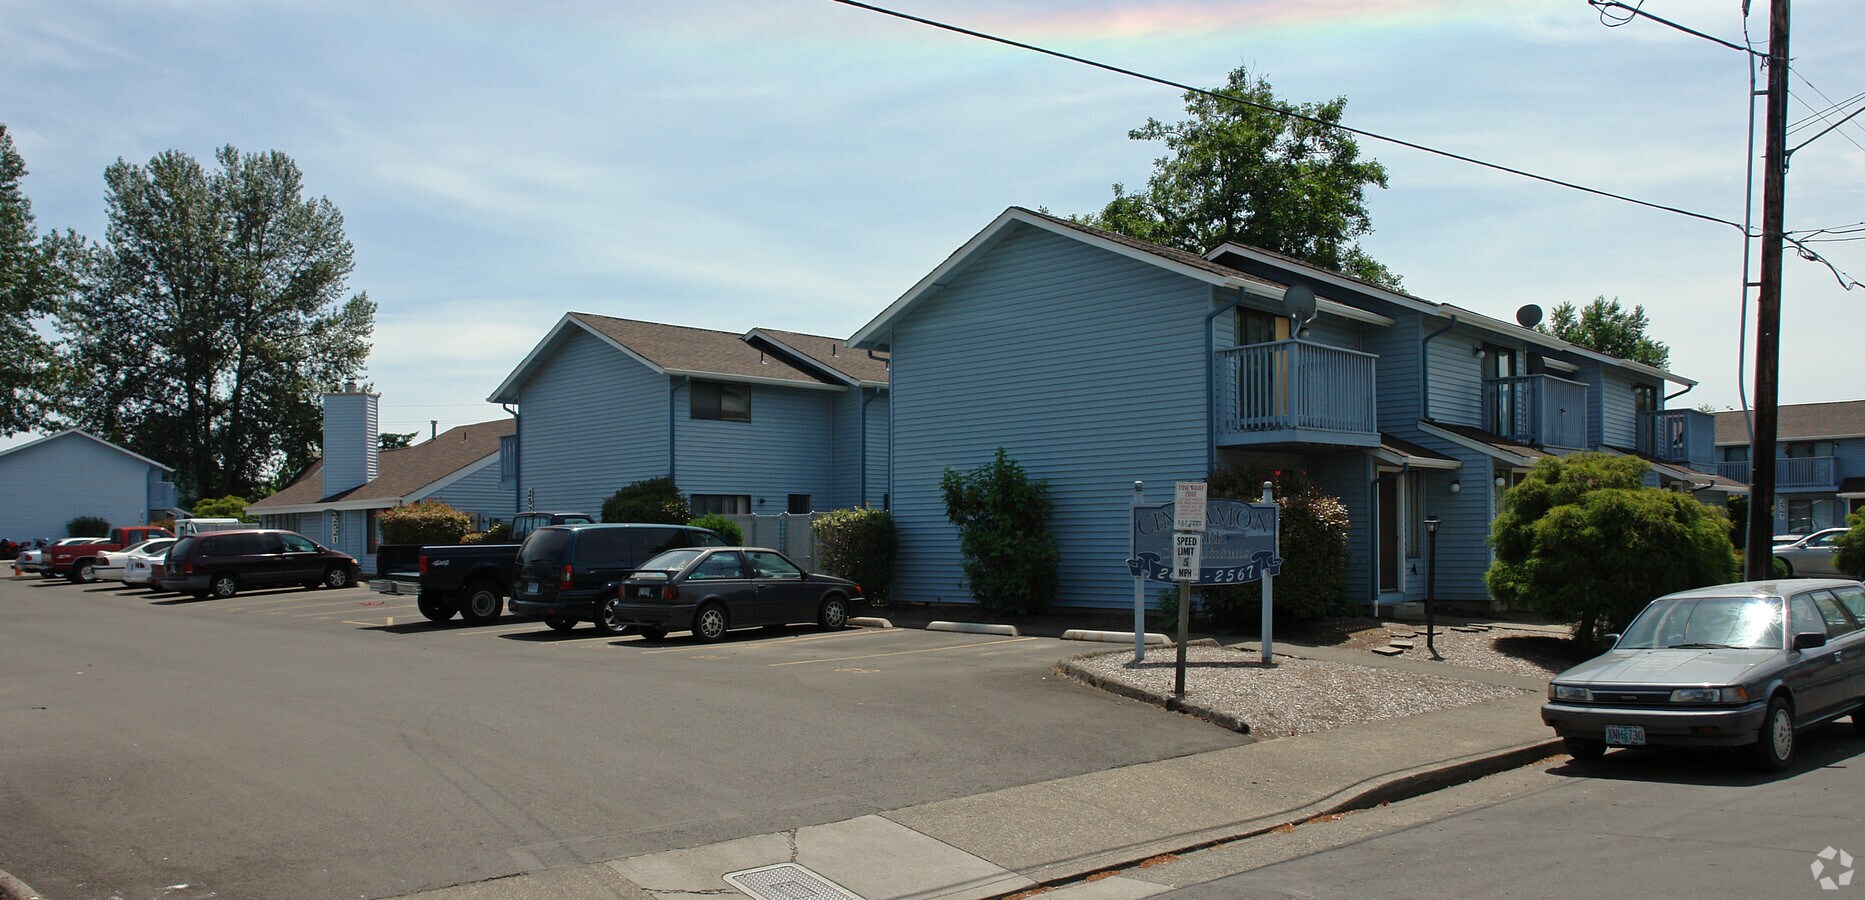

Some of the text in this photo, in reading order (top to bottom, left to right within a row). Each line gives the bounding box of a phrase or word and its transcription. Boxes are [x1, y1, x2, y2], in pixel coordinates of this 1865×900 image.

[1177, 537, 1197, 546] SPEED
[1177, 547, 1195, 556] LIMIT
[1183, 558, 1189, 567] 5
[1178, 568, 1192, 578] MPH
